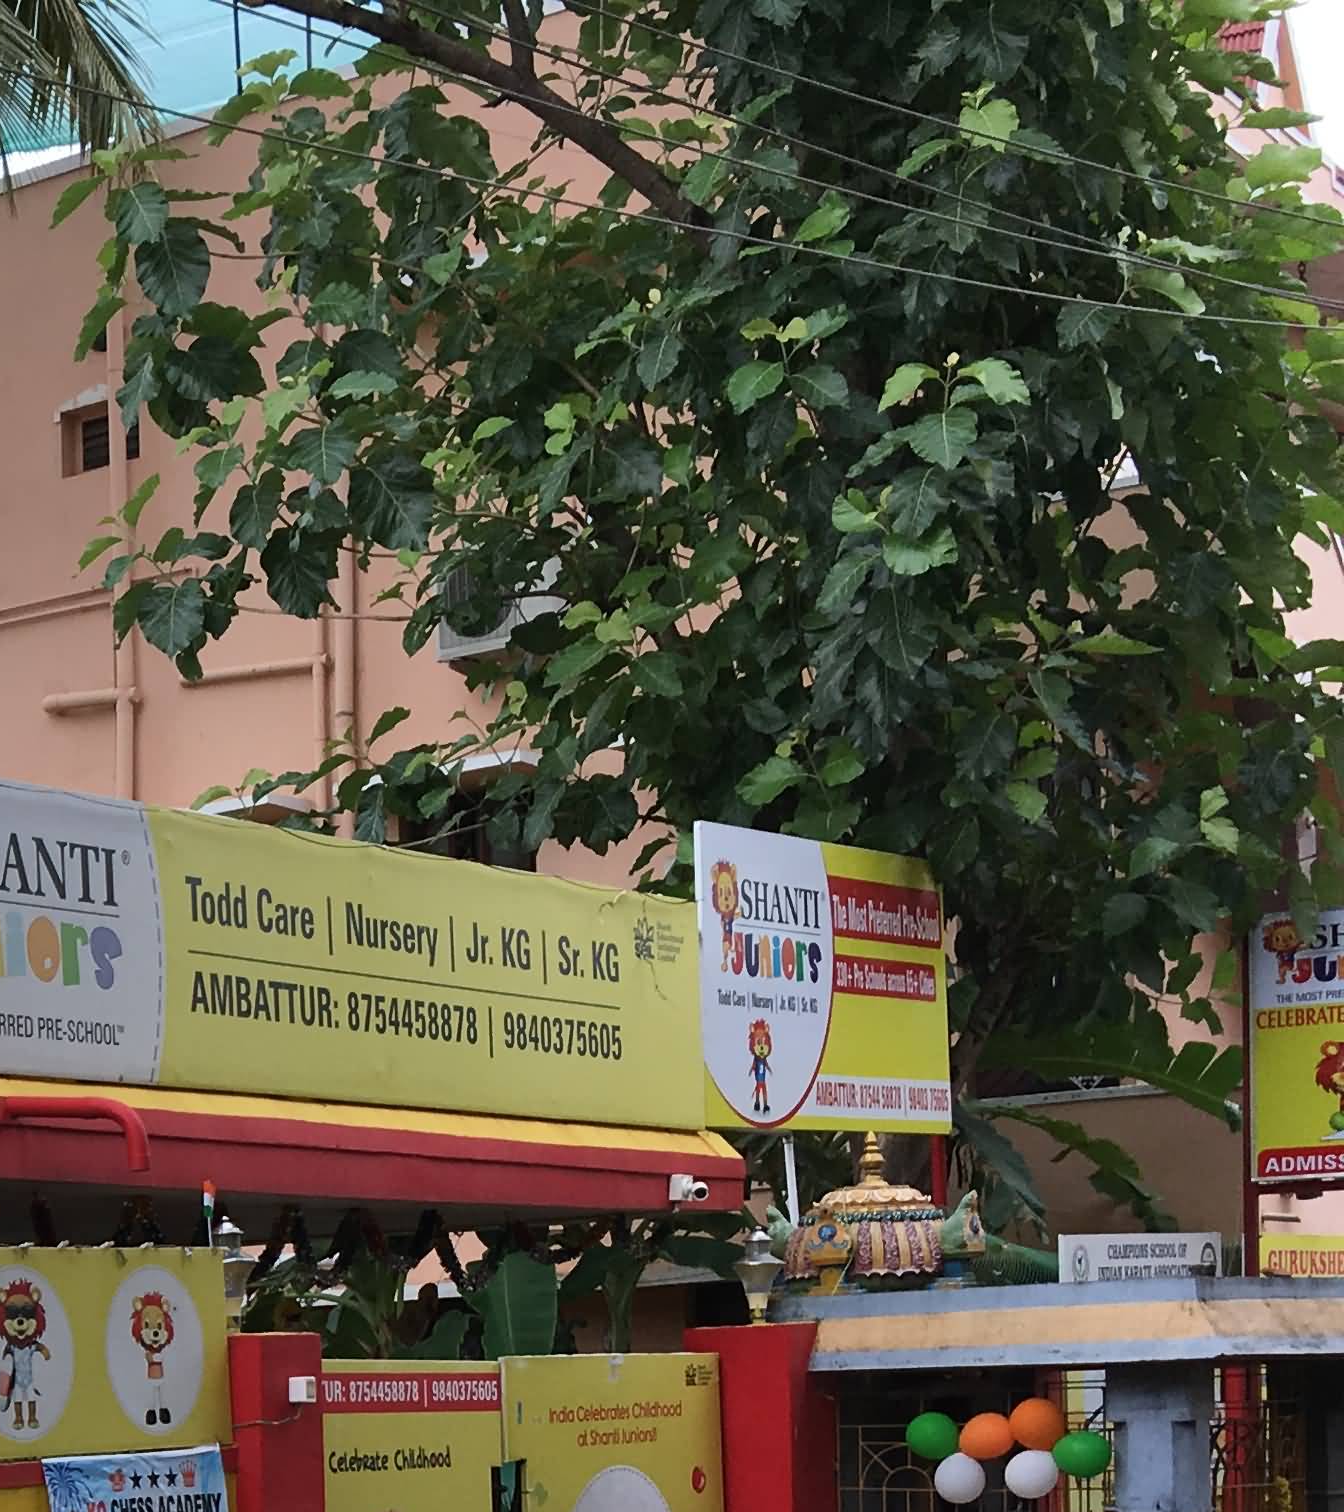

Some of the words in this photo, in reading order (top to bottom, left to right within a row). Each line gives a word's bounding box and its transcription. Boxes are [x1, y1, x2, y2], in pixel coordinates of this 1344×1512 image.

[740, 878, 820, 929] SHANTI
[185, 876, 249, 930] Todd
[256, 887, 315, 940] Care
[345, 901, 439, 968] Nursery
[465, 922, 494, 967] Jr.
[501, 926, 532, 971] KG
[557, 936, 586, 980] Sr.
[591, 938, 621, 983] KG
[832, 894, 847, 930] The
[847, 896, 868, 933] Most
[868, 900, 902, 937] Preferred
[902, 904, 940, 943] Pre-School
[717, 988, 731, 1006] Todd
[752, 991, 773, 1013] Nursery
[1276, 993, 1292, 1003] THE
[1295, 991, 1323, 1002] MOST
[190, 971, 341, 1030] AMBATTUR:
[347, 991, 479, 1046] 8754458878
[503, 1010, 623, 1061] 9840375605
[1107, 1243, 1148, 1260] CHAMPIONS
[1149, 1242, 1177, 1259] SCHOOL
[349, 1380, 419, 1402] 8754458878
[432, 1380, 498, 1401] 9840375605
[548, 1406, 575, 1424] India
[576, 1403, 630, 1422] Celebrates
[631, 1400, 682, 1418] Childhood
[590, 1428, 620, 1446] Shanti
[328, 1447, 389, 1474] Celebrate
[394, 1444, 452, 1471] Childhood
